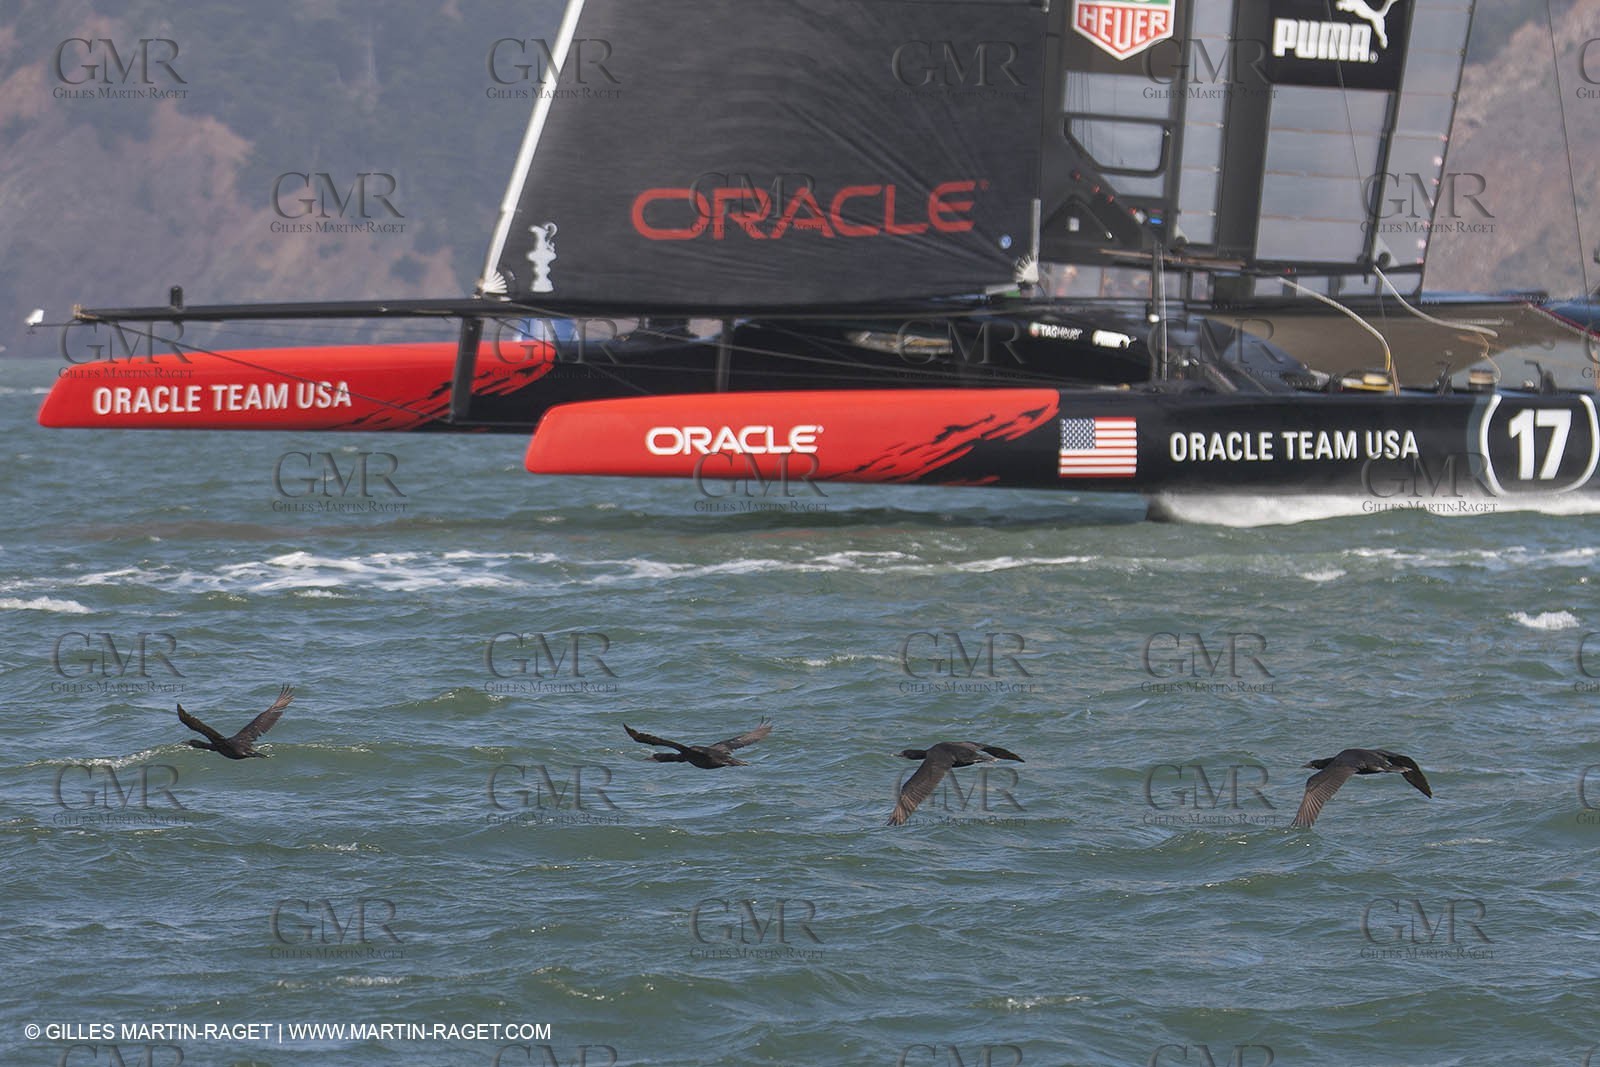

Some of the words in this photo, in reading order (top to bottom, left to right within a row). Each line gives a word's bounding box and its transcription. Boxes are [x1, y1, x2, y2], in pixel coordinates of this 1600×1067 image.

[1079, 6, 1169, 49] HEUER
[1272, 18, 1372, 62] PUMA
[631, 181, 977, 241] ORACLE
[93, 385, 202, 415] ORACLE
[210, 383, 289, 412] TEAM
[296, 380, 353, 409] USA
[645, 425, 818, 456] ORACLE
[1169, 430, 1274, 462] ORACLE
[1282, 429, 1358, 461] TEAM
[1365, 429, 1419, 460] USA
